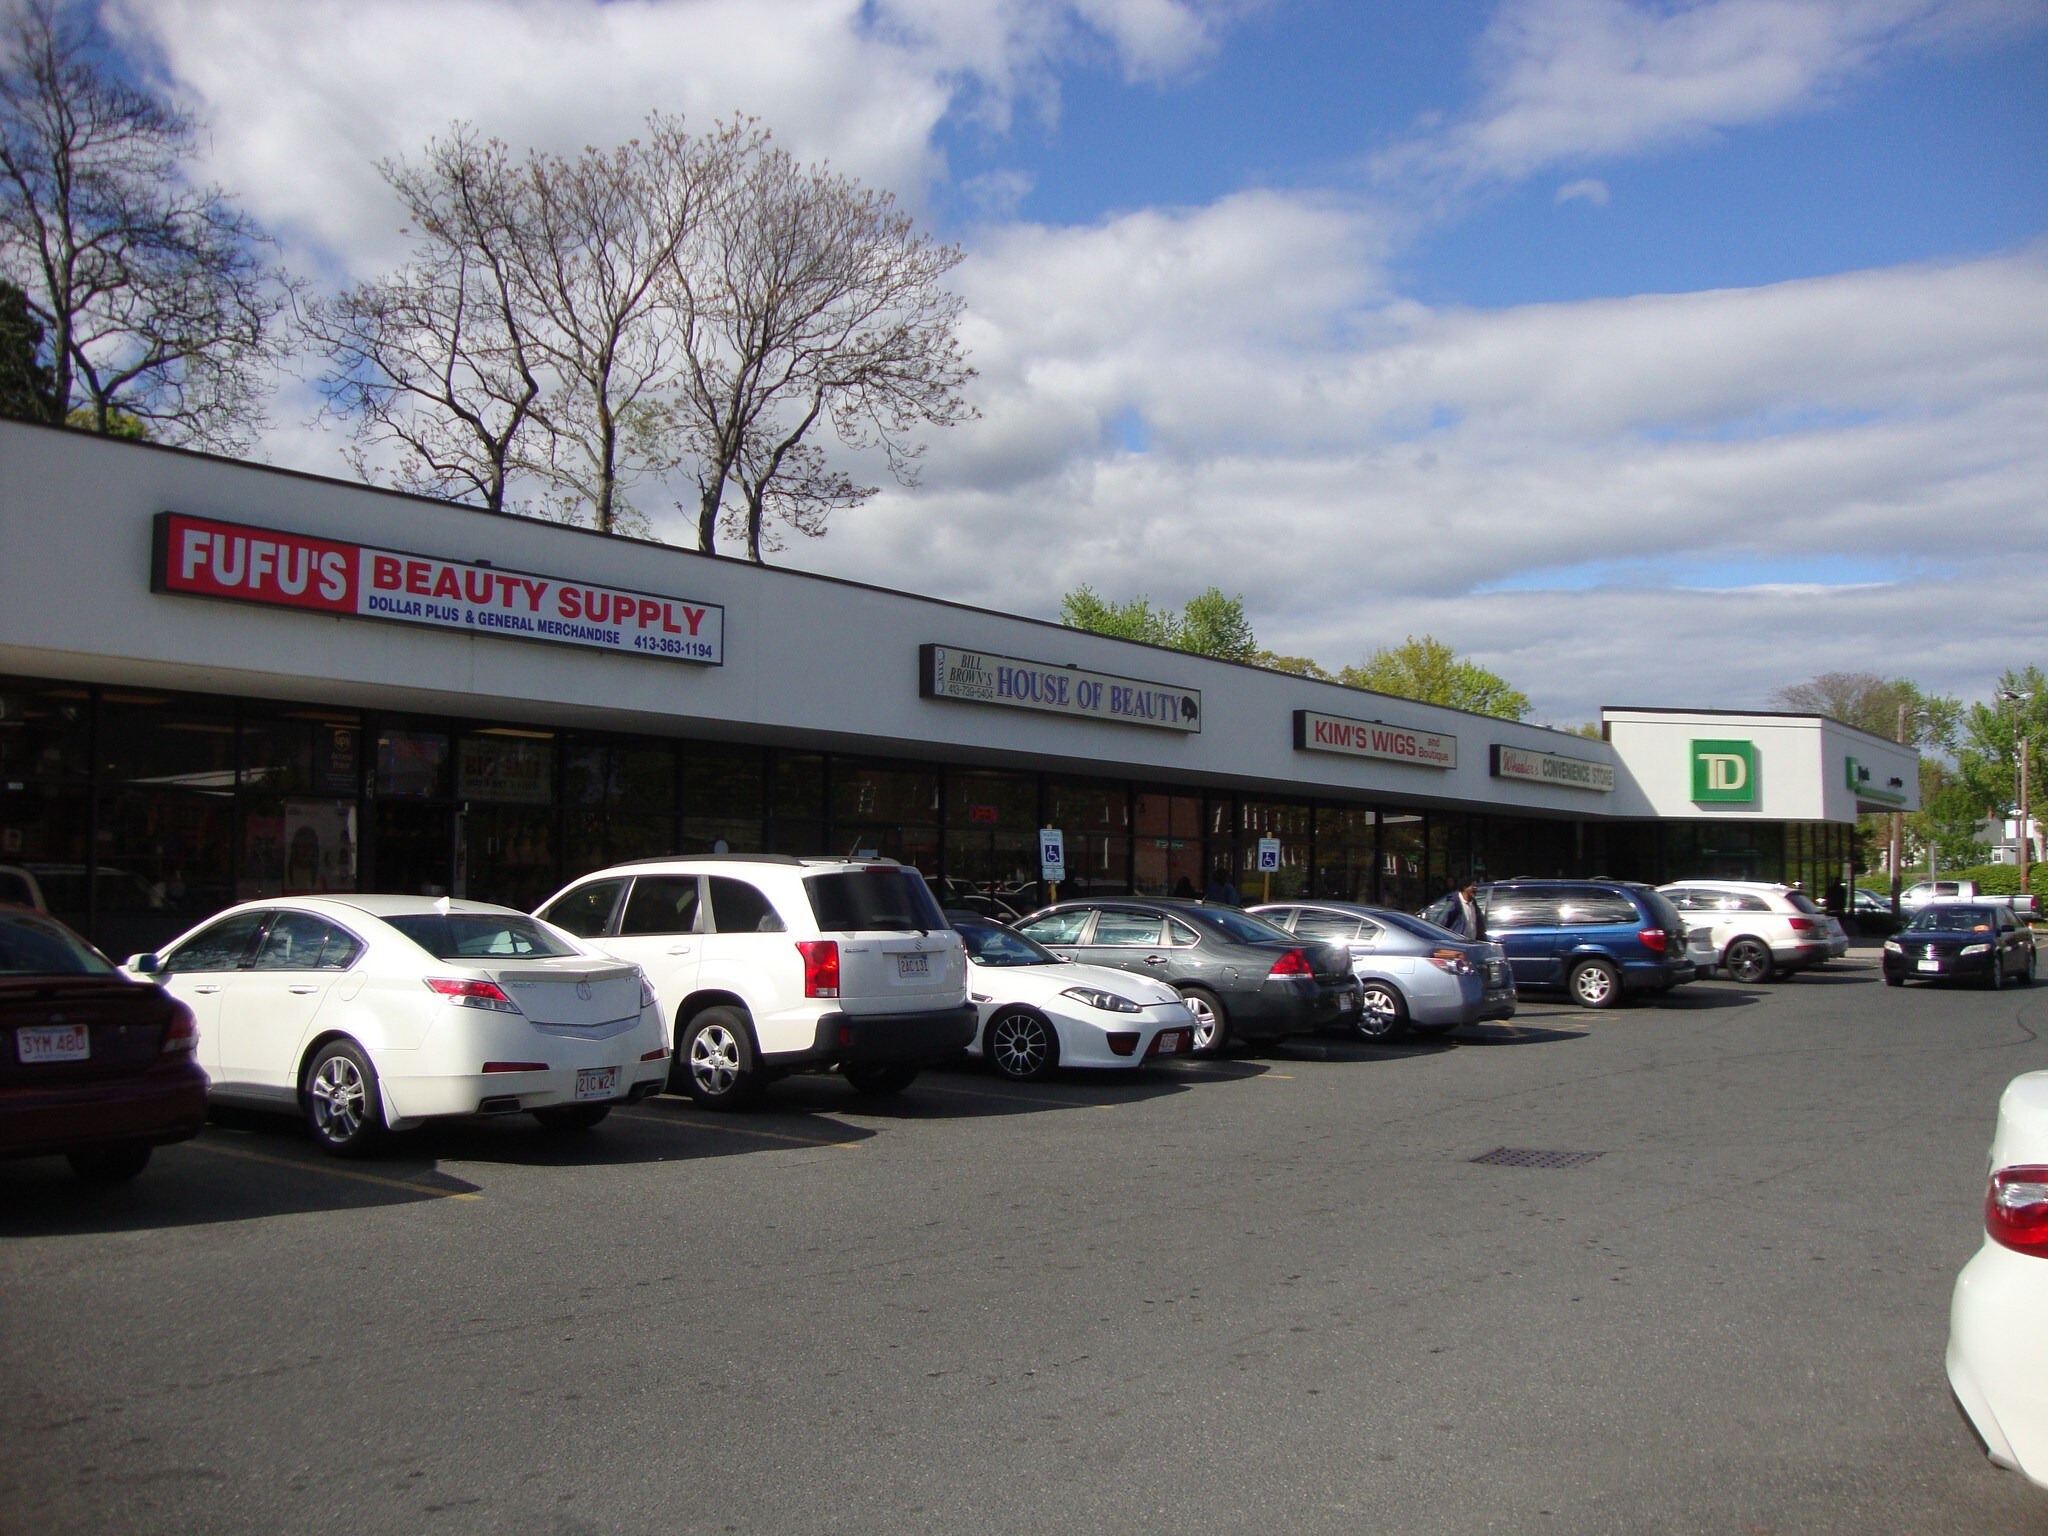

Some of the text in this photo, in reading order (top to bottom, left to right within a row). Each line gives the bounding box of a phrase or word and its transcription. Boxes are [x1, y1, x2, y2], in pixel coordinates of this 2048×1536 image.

[181, 528, 347, 601] FUFU'S
[373, 555, 706, 636] BEAUTY SUPPLY
[368, 595, 620, 644] DOLLAR PLUS & GENERAL MERCHANDISE
[634, 635, 713, 658] 413-363-1194
[961, 654, 983, 671] BILL
[949, 667, 993, 687] BROWN'S
[996, 666, 1180, 723] HOUSE OF BEAUTY
[1315, 720, 1416, 756] KIM'S WIGS
[1418, 746, 1449, 762] Boutique
[1427, 737, 1440, 747] and
[1543, 758, 1590, 783] CONVENIENCE
[1592, 767, 1613, 787] STORE
[1697, 753, 1747, 790] TD
